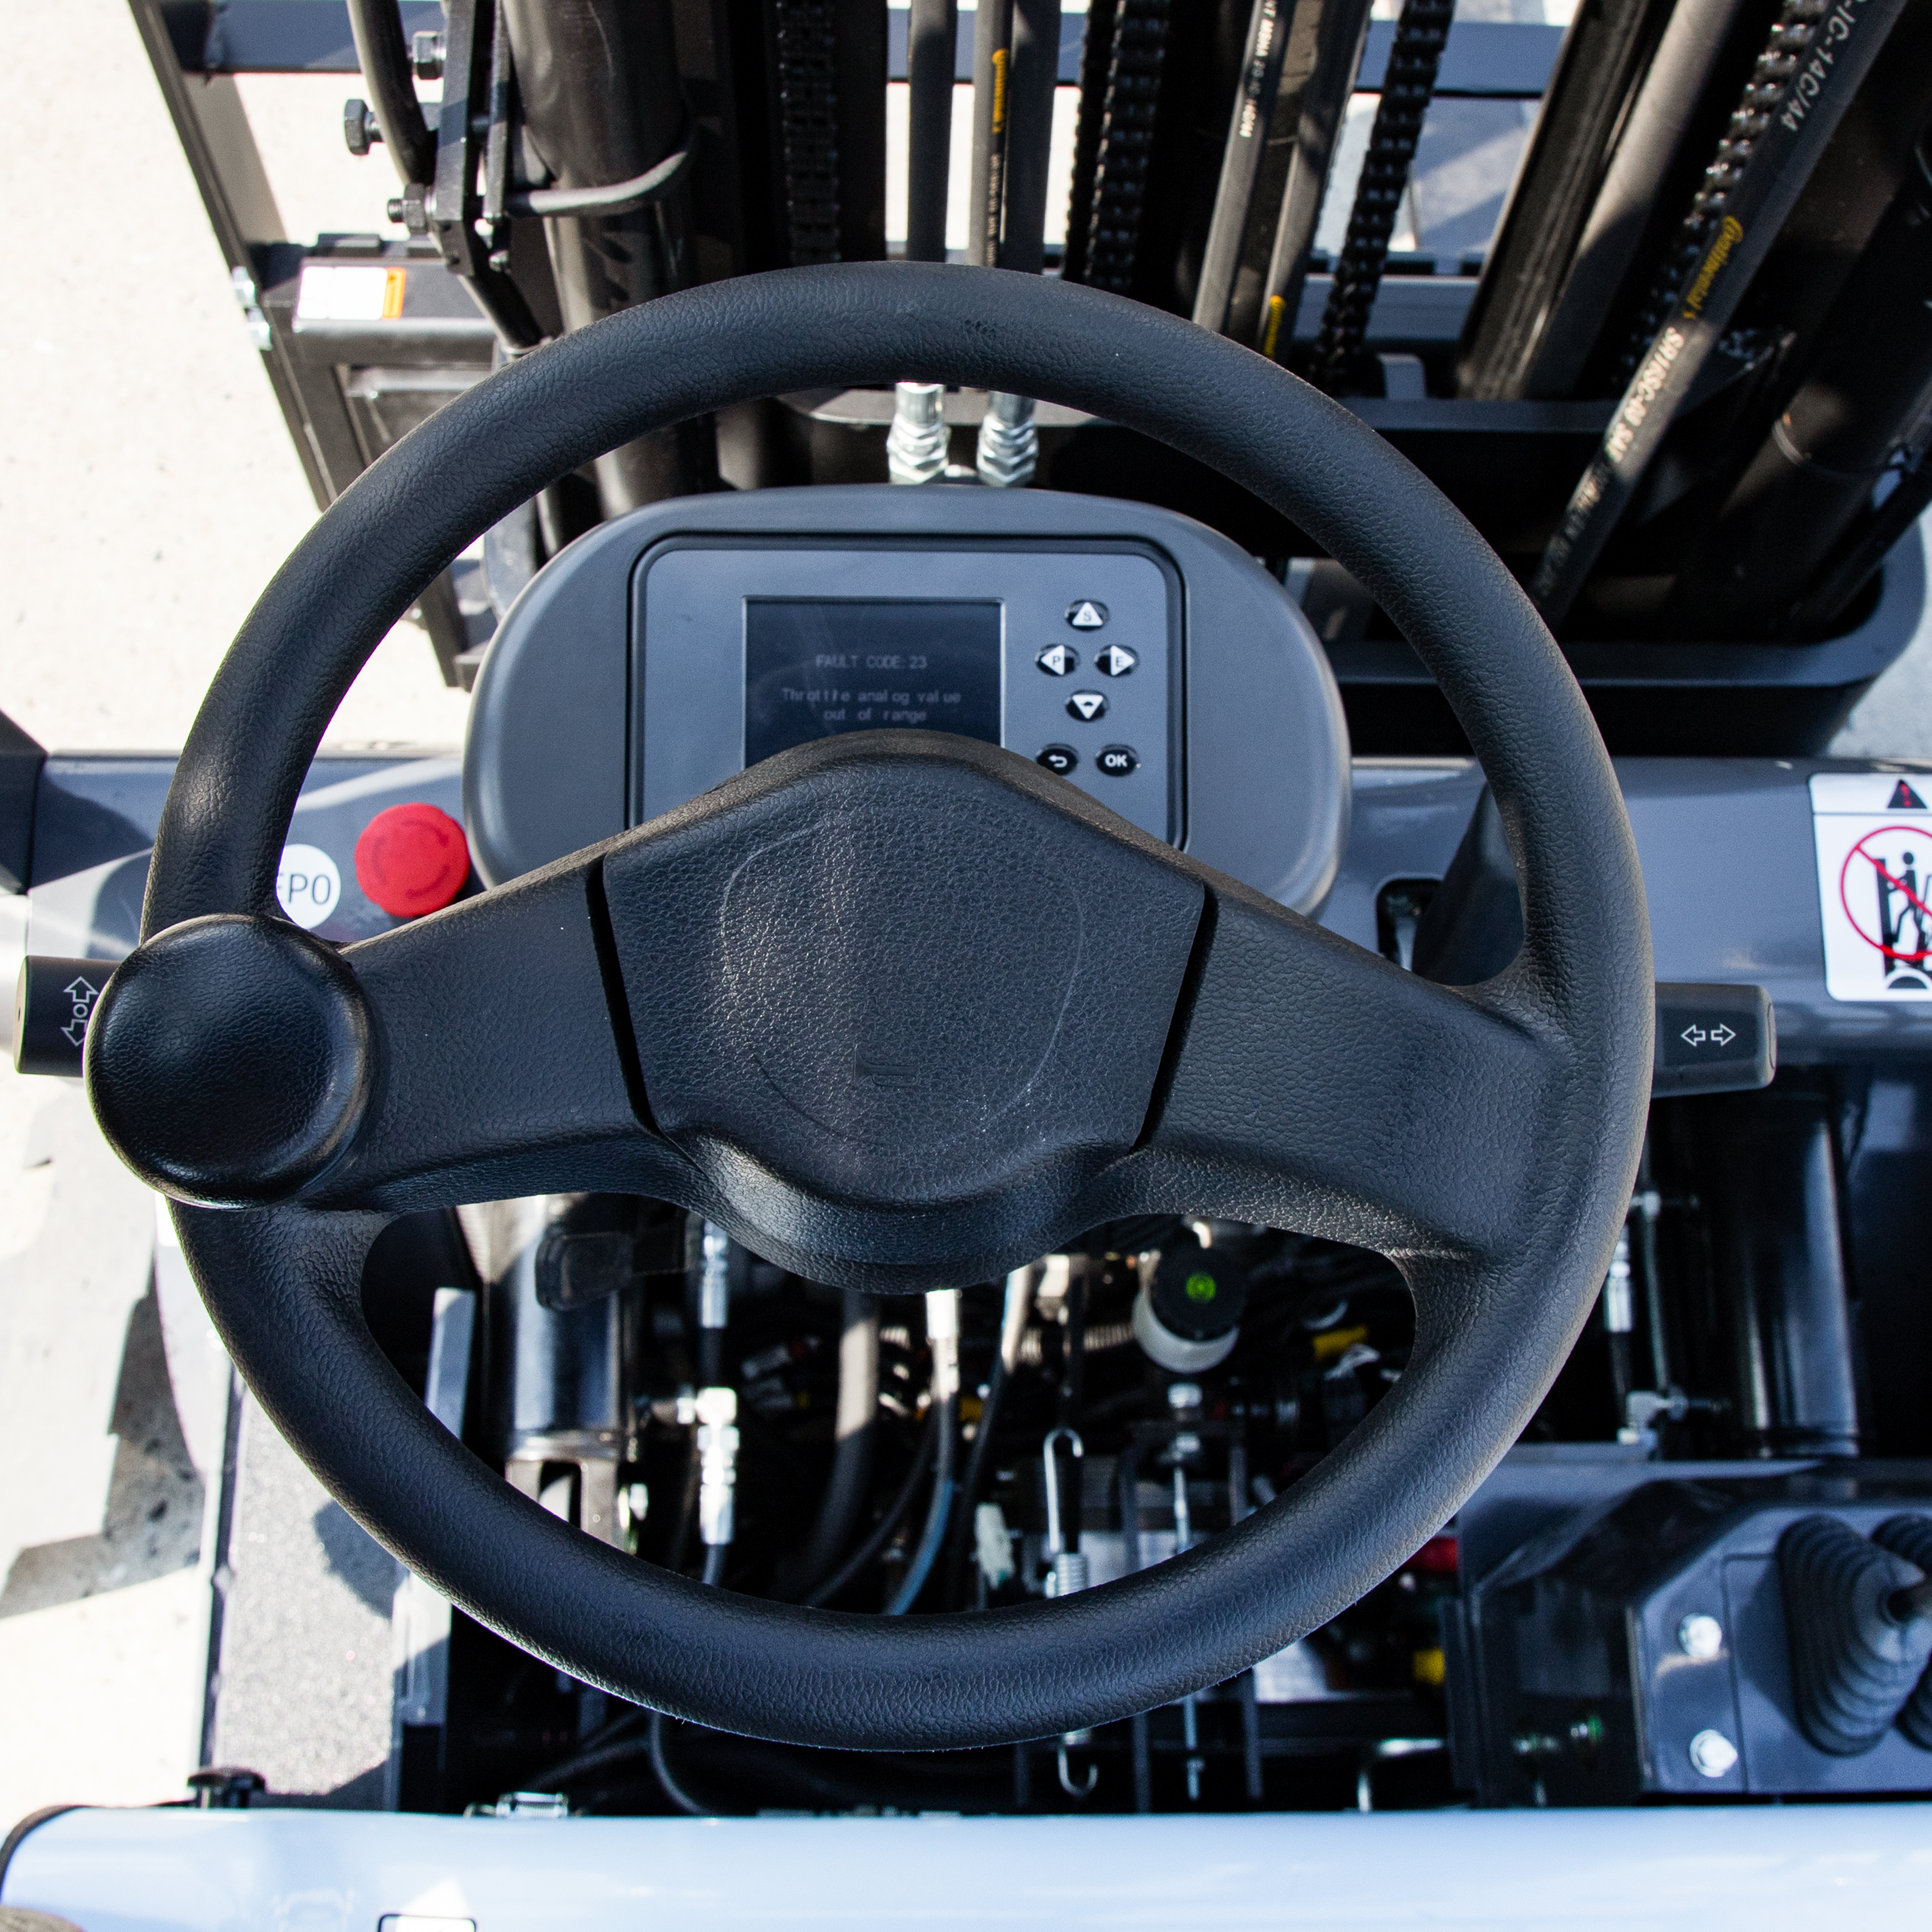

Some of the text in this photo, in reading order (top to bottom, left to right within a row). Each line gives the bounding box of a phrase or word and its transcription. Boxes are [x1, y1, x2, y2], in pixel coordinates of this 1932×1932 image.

[1083, 611, 1092, 622] S
[815, 654, 859, 669] FAULT
[909, 655, 928, 669] 23
[1052, 656, 1061, 667] P
[1115, 656, 1124, 668] E
[857, 689, 910, 706] analog
[918, 689, 962, 703] value
[823, 707, 927, 724] out of range
[1105, 754, 1128, 767] OK
